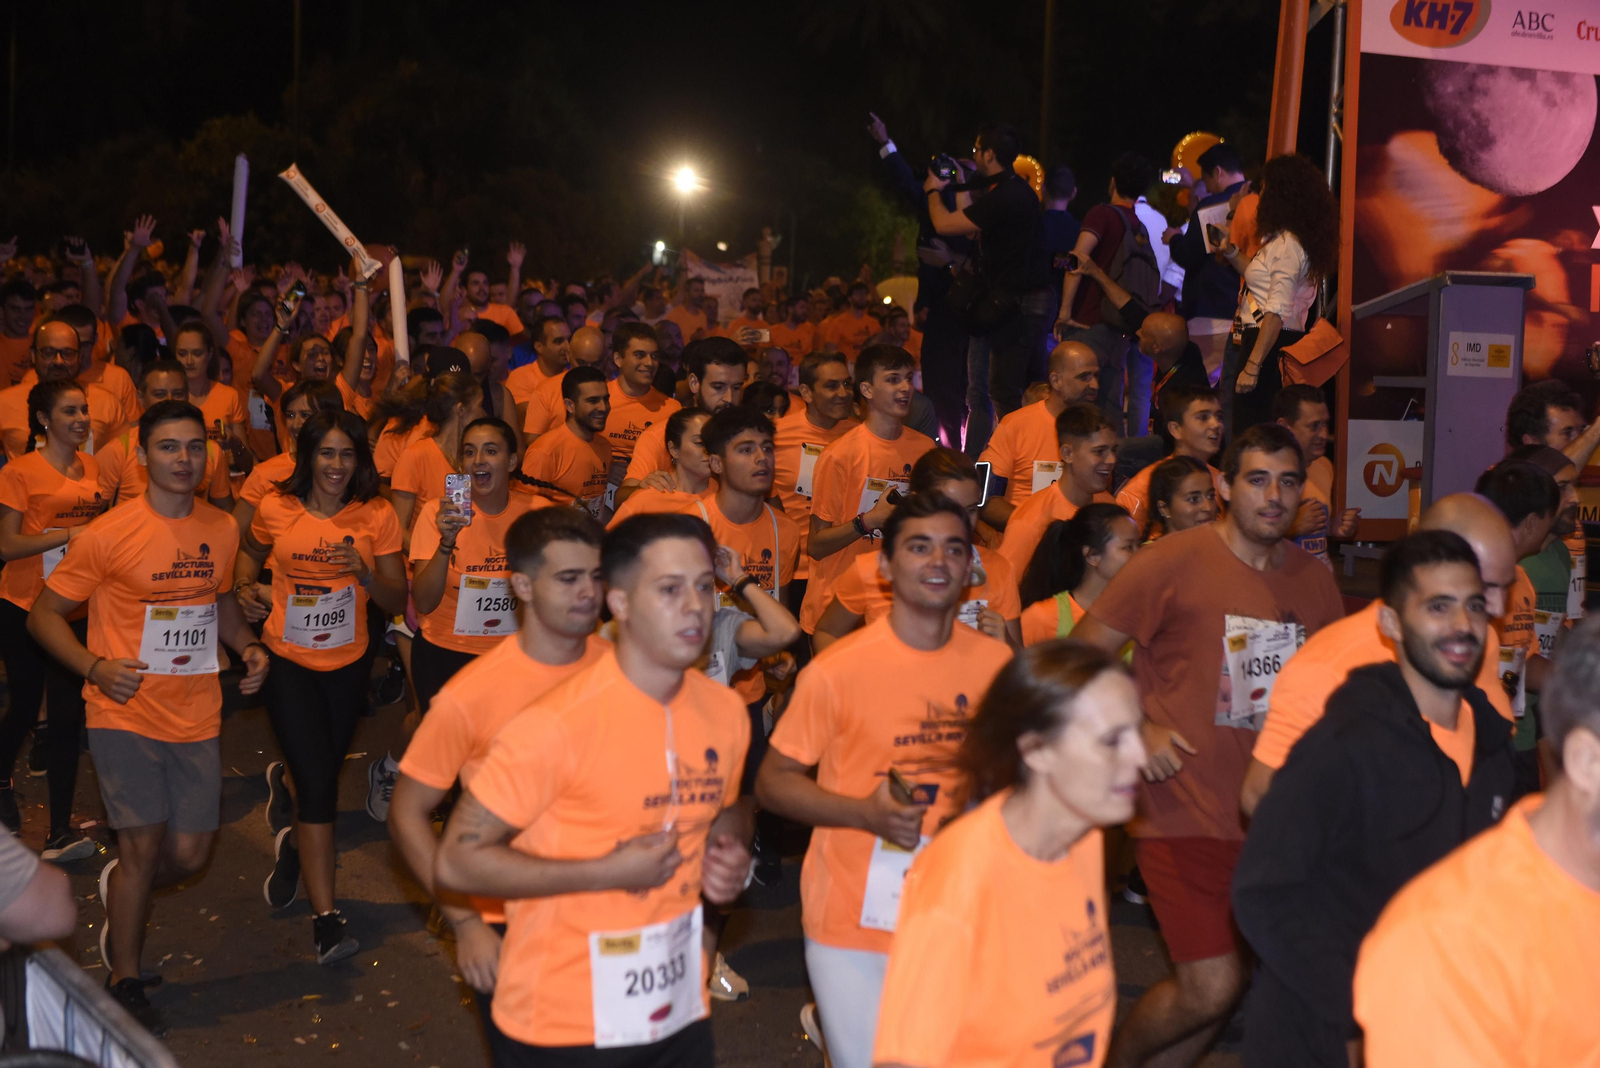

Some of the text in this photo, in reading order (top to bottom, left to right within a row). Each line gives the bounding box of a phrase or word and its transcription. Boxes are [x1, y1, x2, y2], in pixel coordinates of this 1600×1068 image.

[1512, 10, 1555, 33] ABC
[1466, 342, 1482, 353] IMD
[172, 561, 214, 569] NOCTURNA
[466, 564, 503, 573] SEVILLA
[151, 569, 192, 581] SEVILLA
[475, 597, 519, 612] 12580
[303, 608, 346, 628] 11099
[163, 627, 207, 647] 11101
[1241, 653, 1282, 681] 14366
